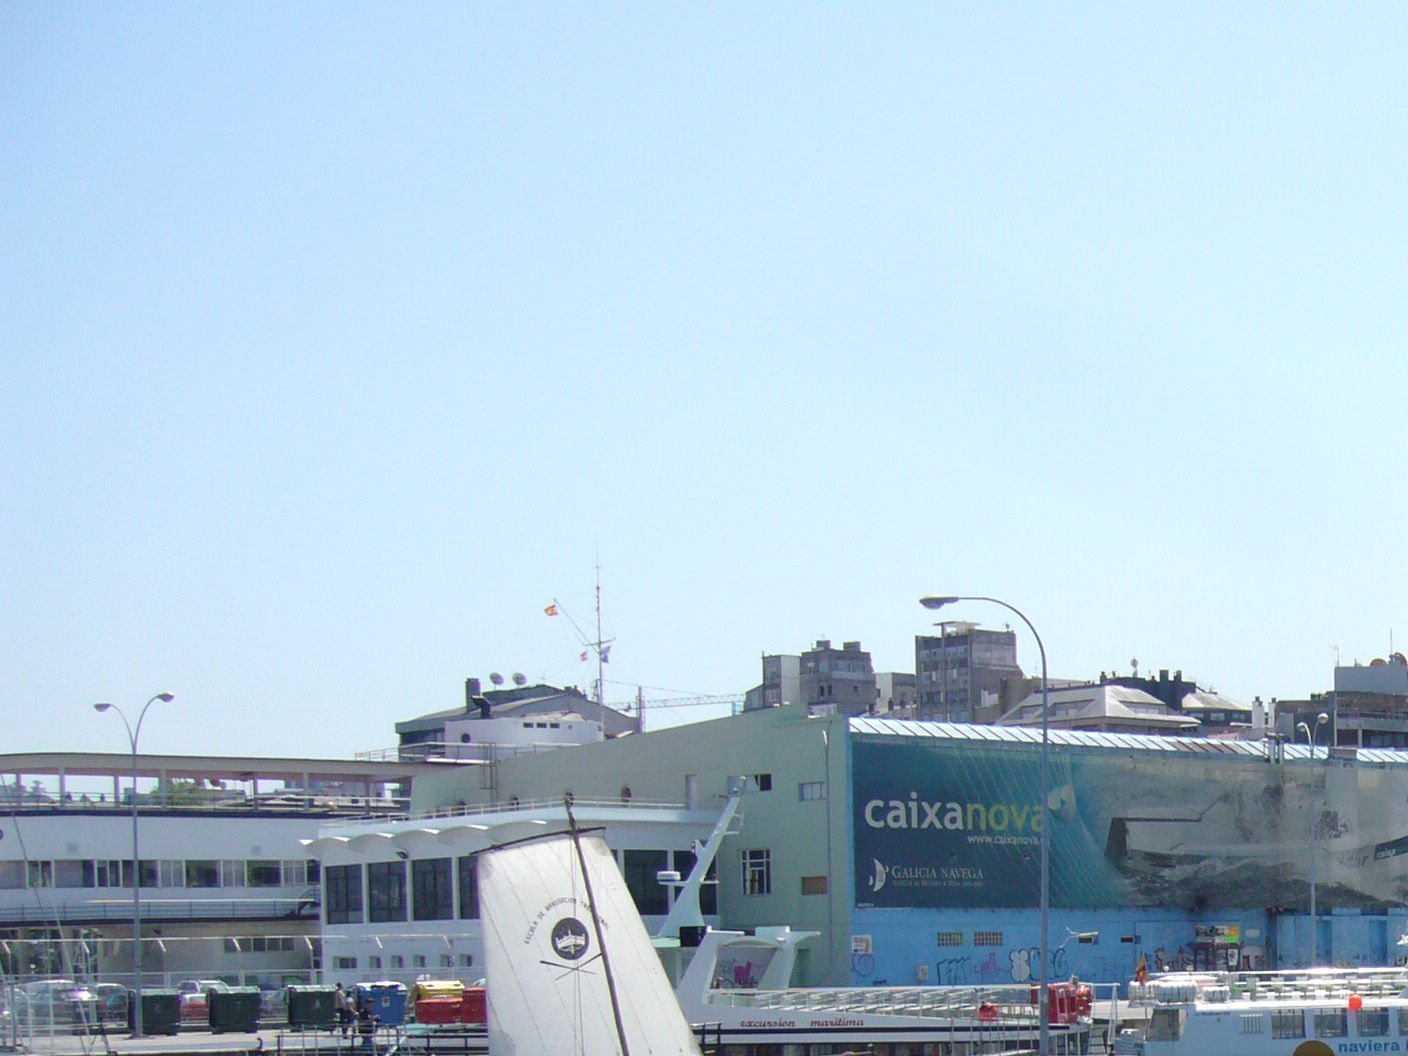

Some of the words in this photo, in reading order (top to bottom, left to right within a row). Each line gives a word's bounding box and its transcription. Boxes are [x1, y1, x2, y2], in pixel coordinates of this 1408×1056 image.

[892, 866, 937, 879] GALICIA
[941, 867, 984, 880] NAVEGA
[740, 1017, 796, 1028] excursion
[1338, 1040, 1400, 1053] naviera
